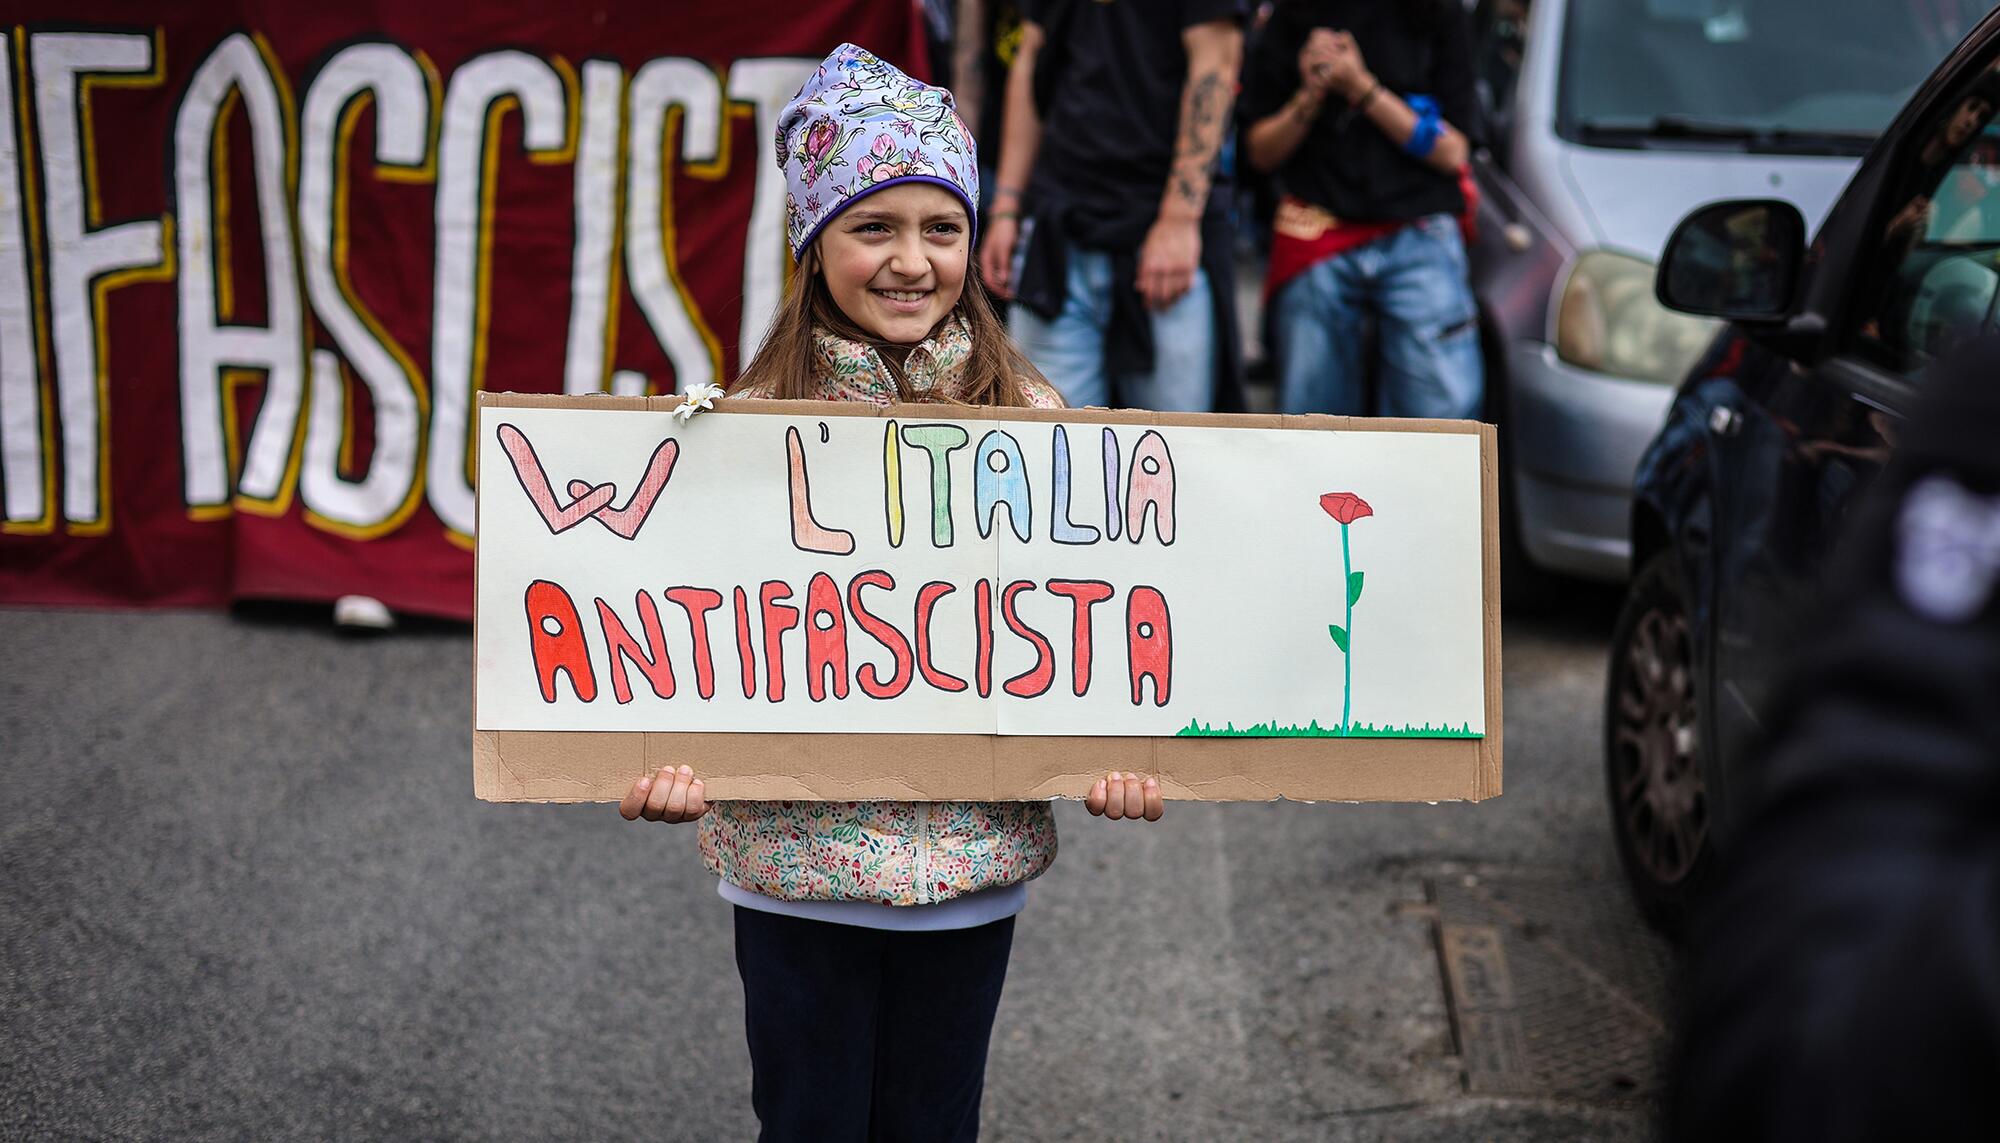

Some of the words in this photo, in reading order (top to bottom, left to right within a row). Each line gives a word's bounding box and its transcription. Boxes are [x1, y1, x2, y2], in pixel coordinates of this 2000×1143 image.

[496, 423, 680, 541] W
[785, 418, 1177, 556] L'ITALIA
[524, 569, 1172, 707] ANTIFASCISTA
